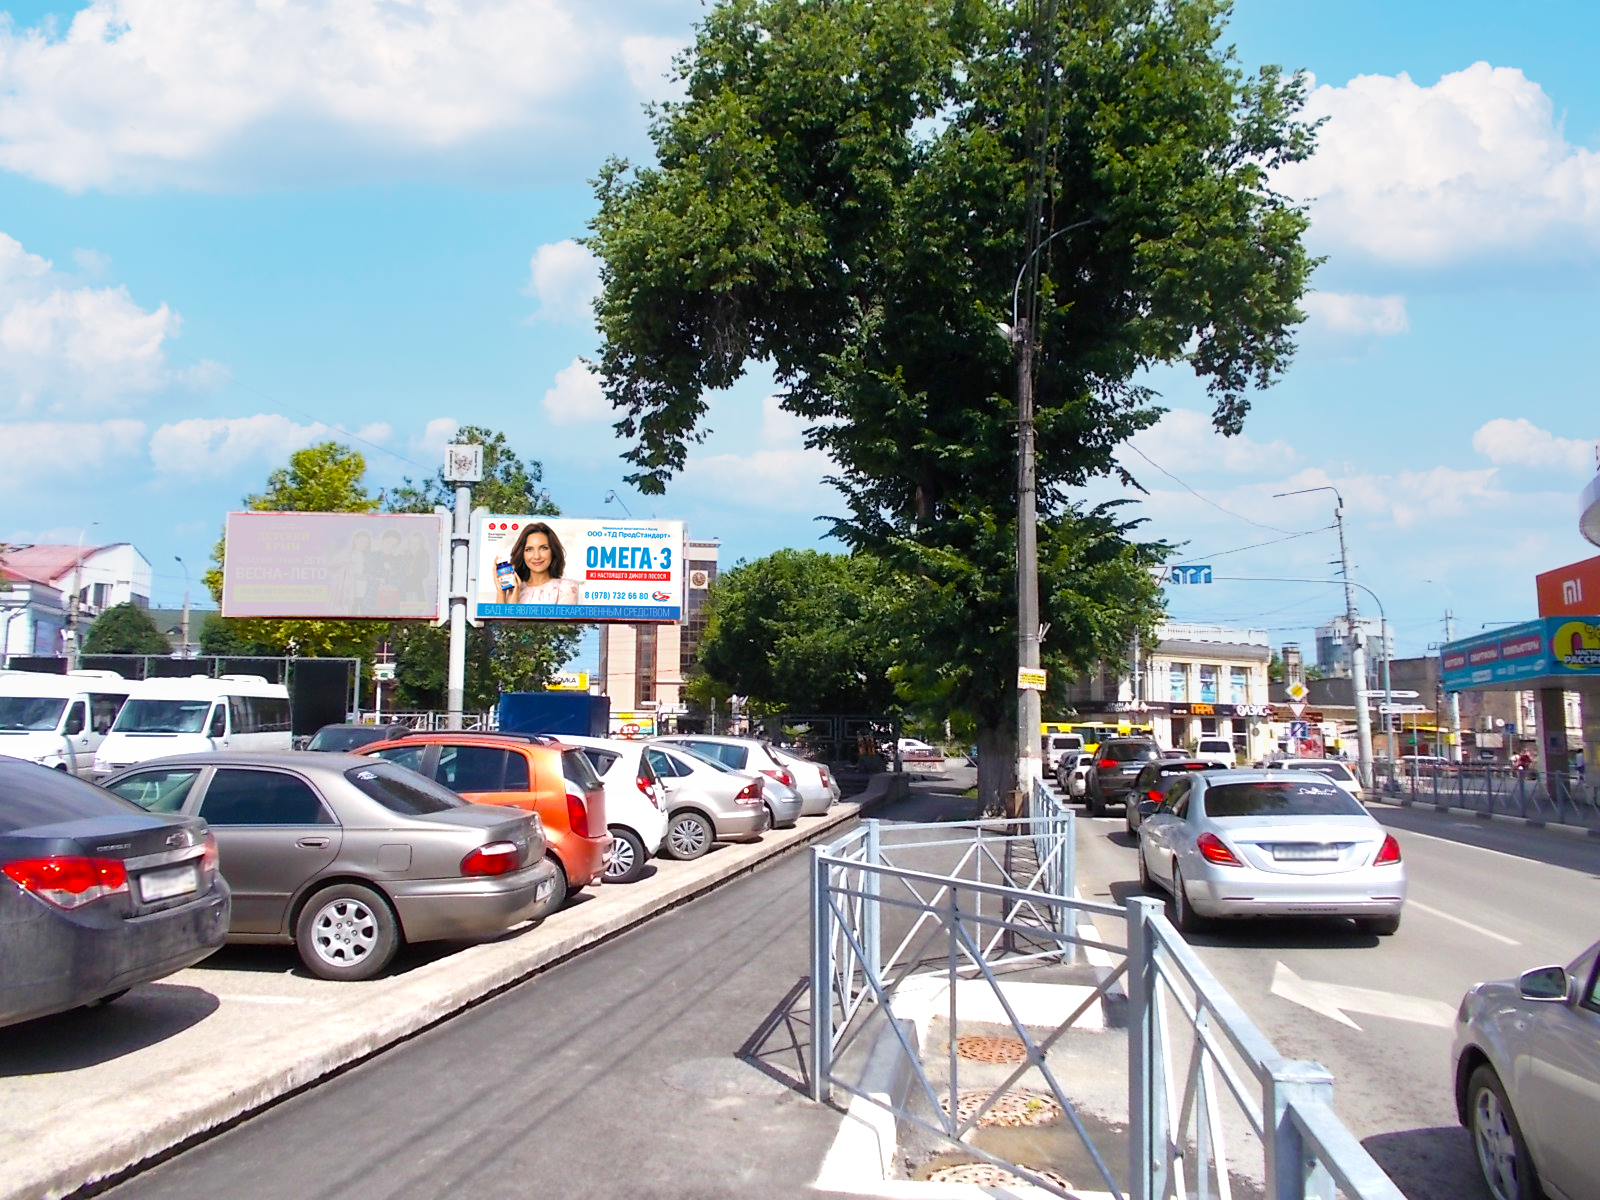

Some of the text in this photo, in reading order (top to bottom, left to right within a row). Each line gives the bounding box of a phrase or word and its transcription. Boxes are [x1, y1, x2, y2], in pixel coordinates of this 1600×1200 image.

[604, 531, 618, 539] «ТД
[619, 531, 671, 540] ПродСтандарт»
[265, 542, 301, 551] КРЫМ
[303, 555, 328, 565] 2019
[597, 572, 628, 580] НАСТОЯЩЕГО
[584, 591, 649, 601] 8 (978) 732 66 80
[504, 605, 515, 616] НЕ
[515, 605, 555, 616] ЯВЛЯЕТСЯ
[555, 606, 623, 617] ЛЕКАРСТВЕННЫМ
[623, 607, 670, 618] СРЕДСТВОМ
